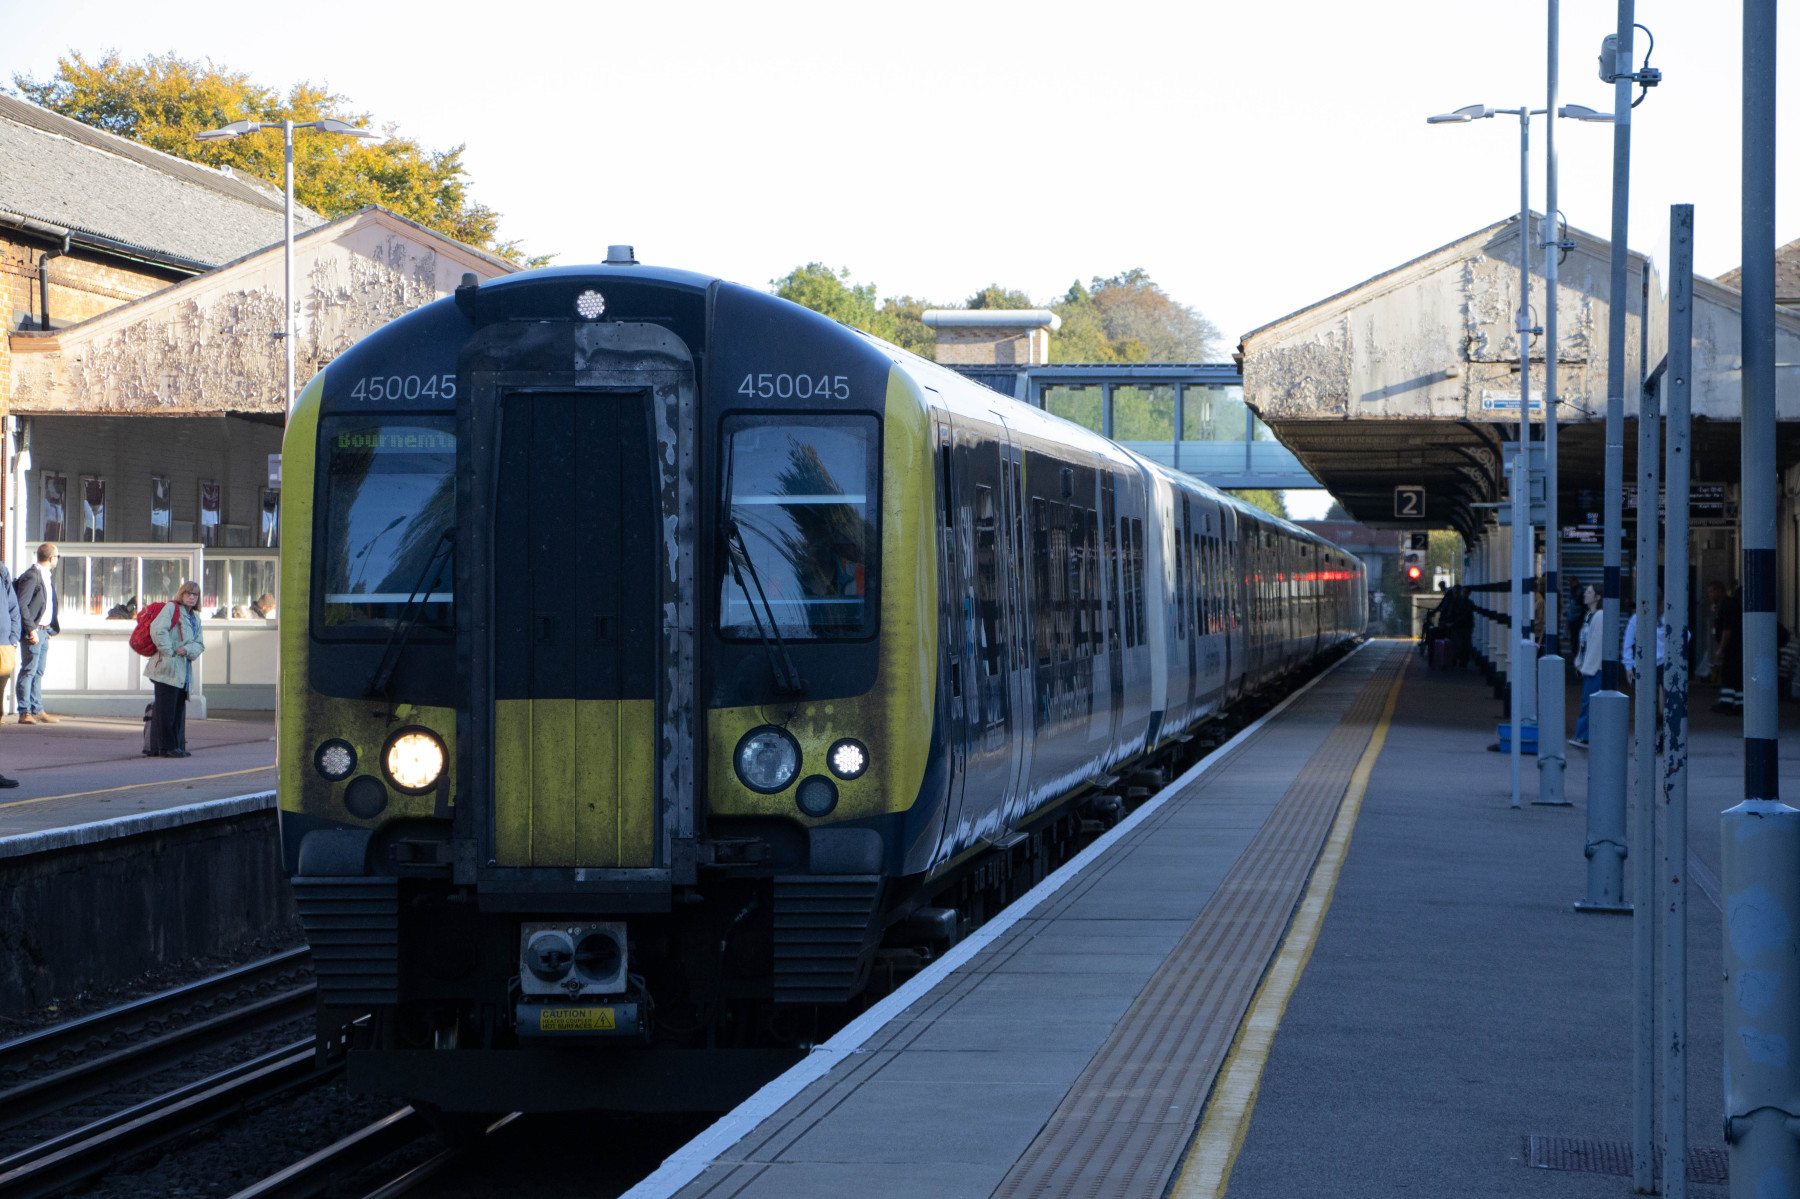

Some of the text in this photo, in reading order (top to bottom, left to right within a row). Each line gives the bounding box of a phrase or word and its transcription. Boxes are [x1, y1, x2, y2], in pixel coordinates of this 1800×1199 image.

[350, 374, 456, 401] 450045
[738, 373, 851, 400] 450045
[1402, 492, 1418, 514] 2
[1415, 535, 1426, 548] 2
[543, 1010, 586, 1018] CAUTION
